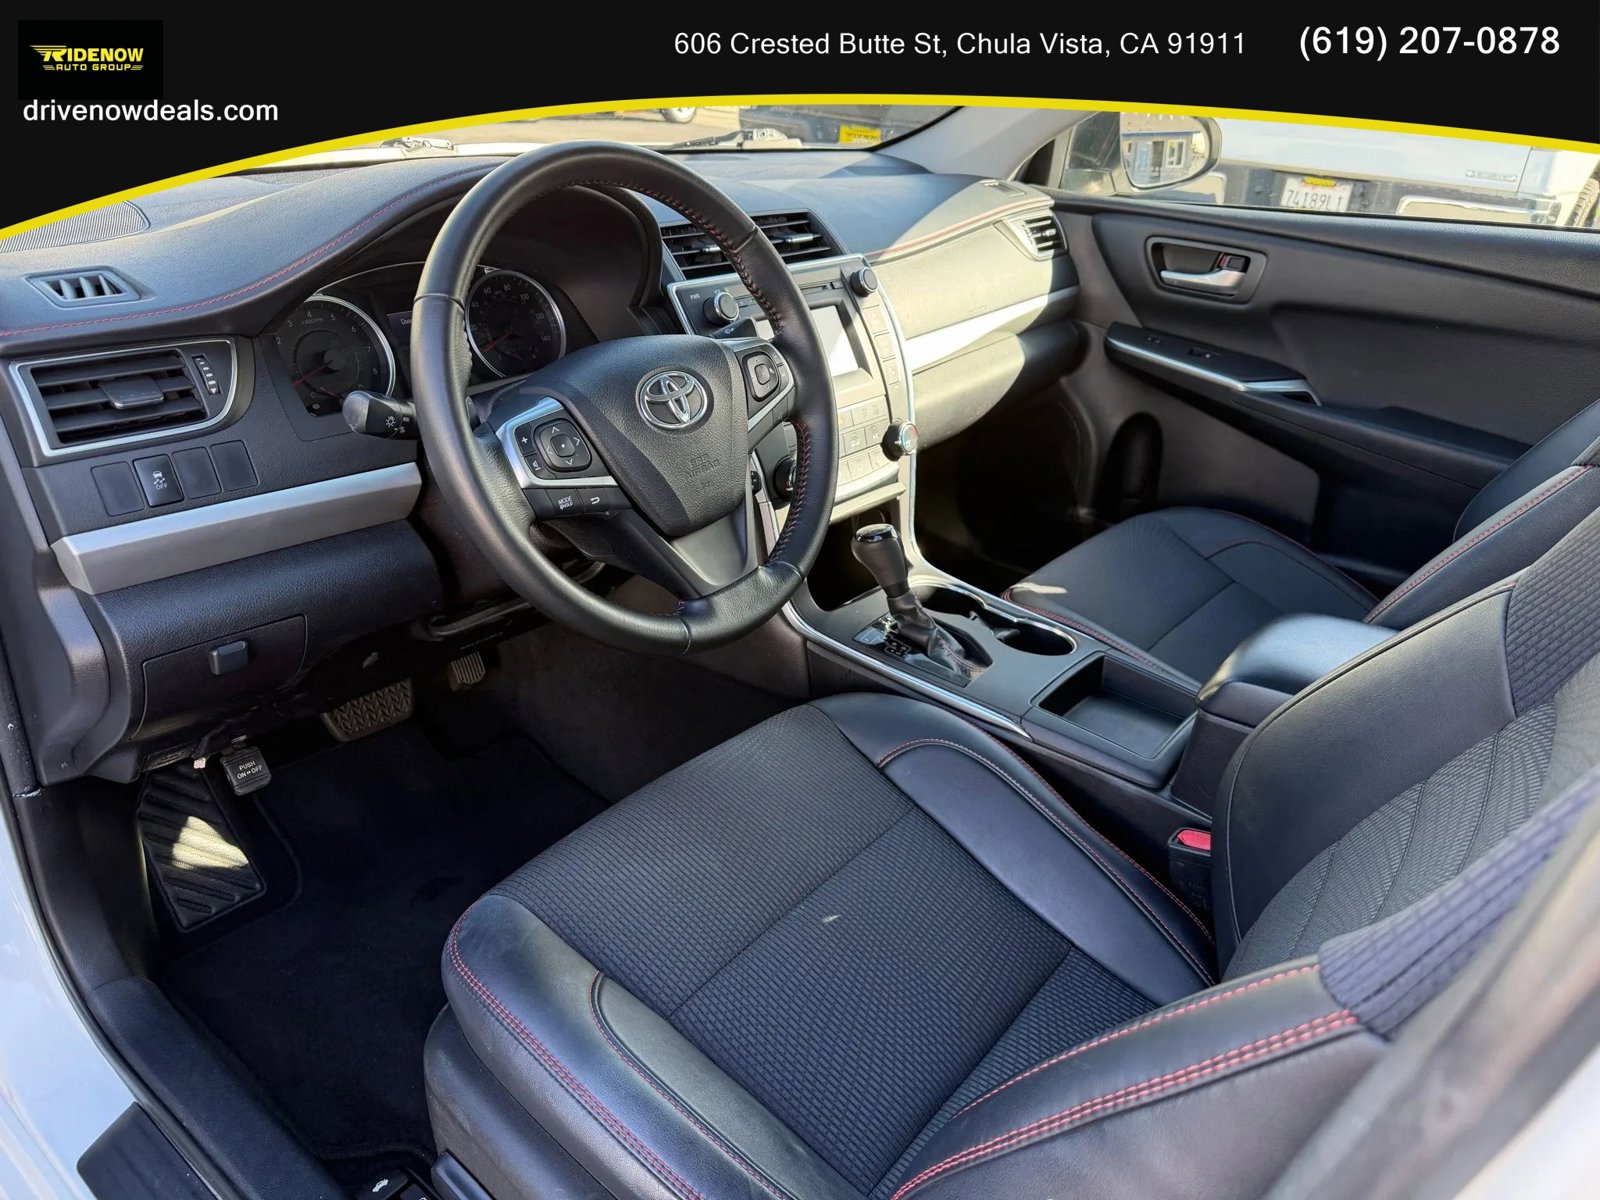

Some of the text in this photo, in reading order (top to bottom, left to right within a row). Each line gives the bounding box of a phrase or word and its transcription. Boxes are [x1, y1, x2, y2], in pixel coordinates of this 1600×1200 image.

[239, 760, 256, 771] PUSH
[237, 765, 262, 779] ON OFF
